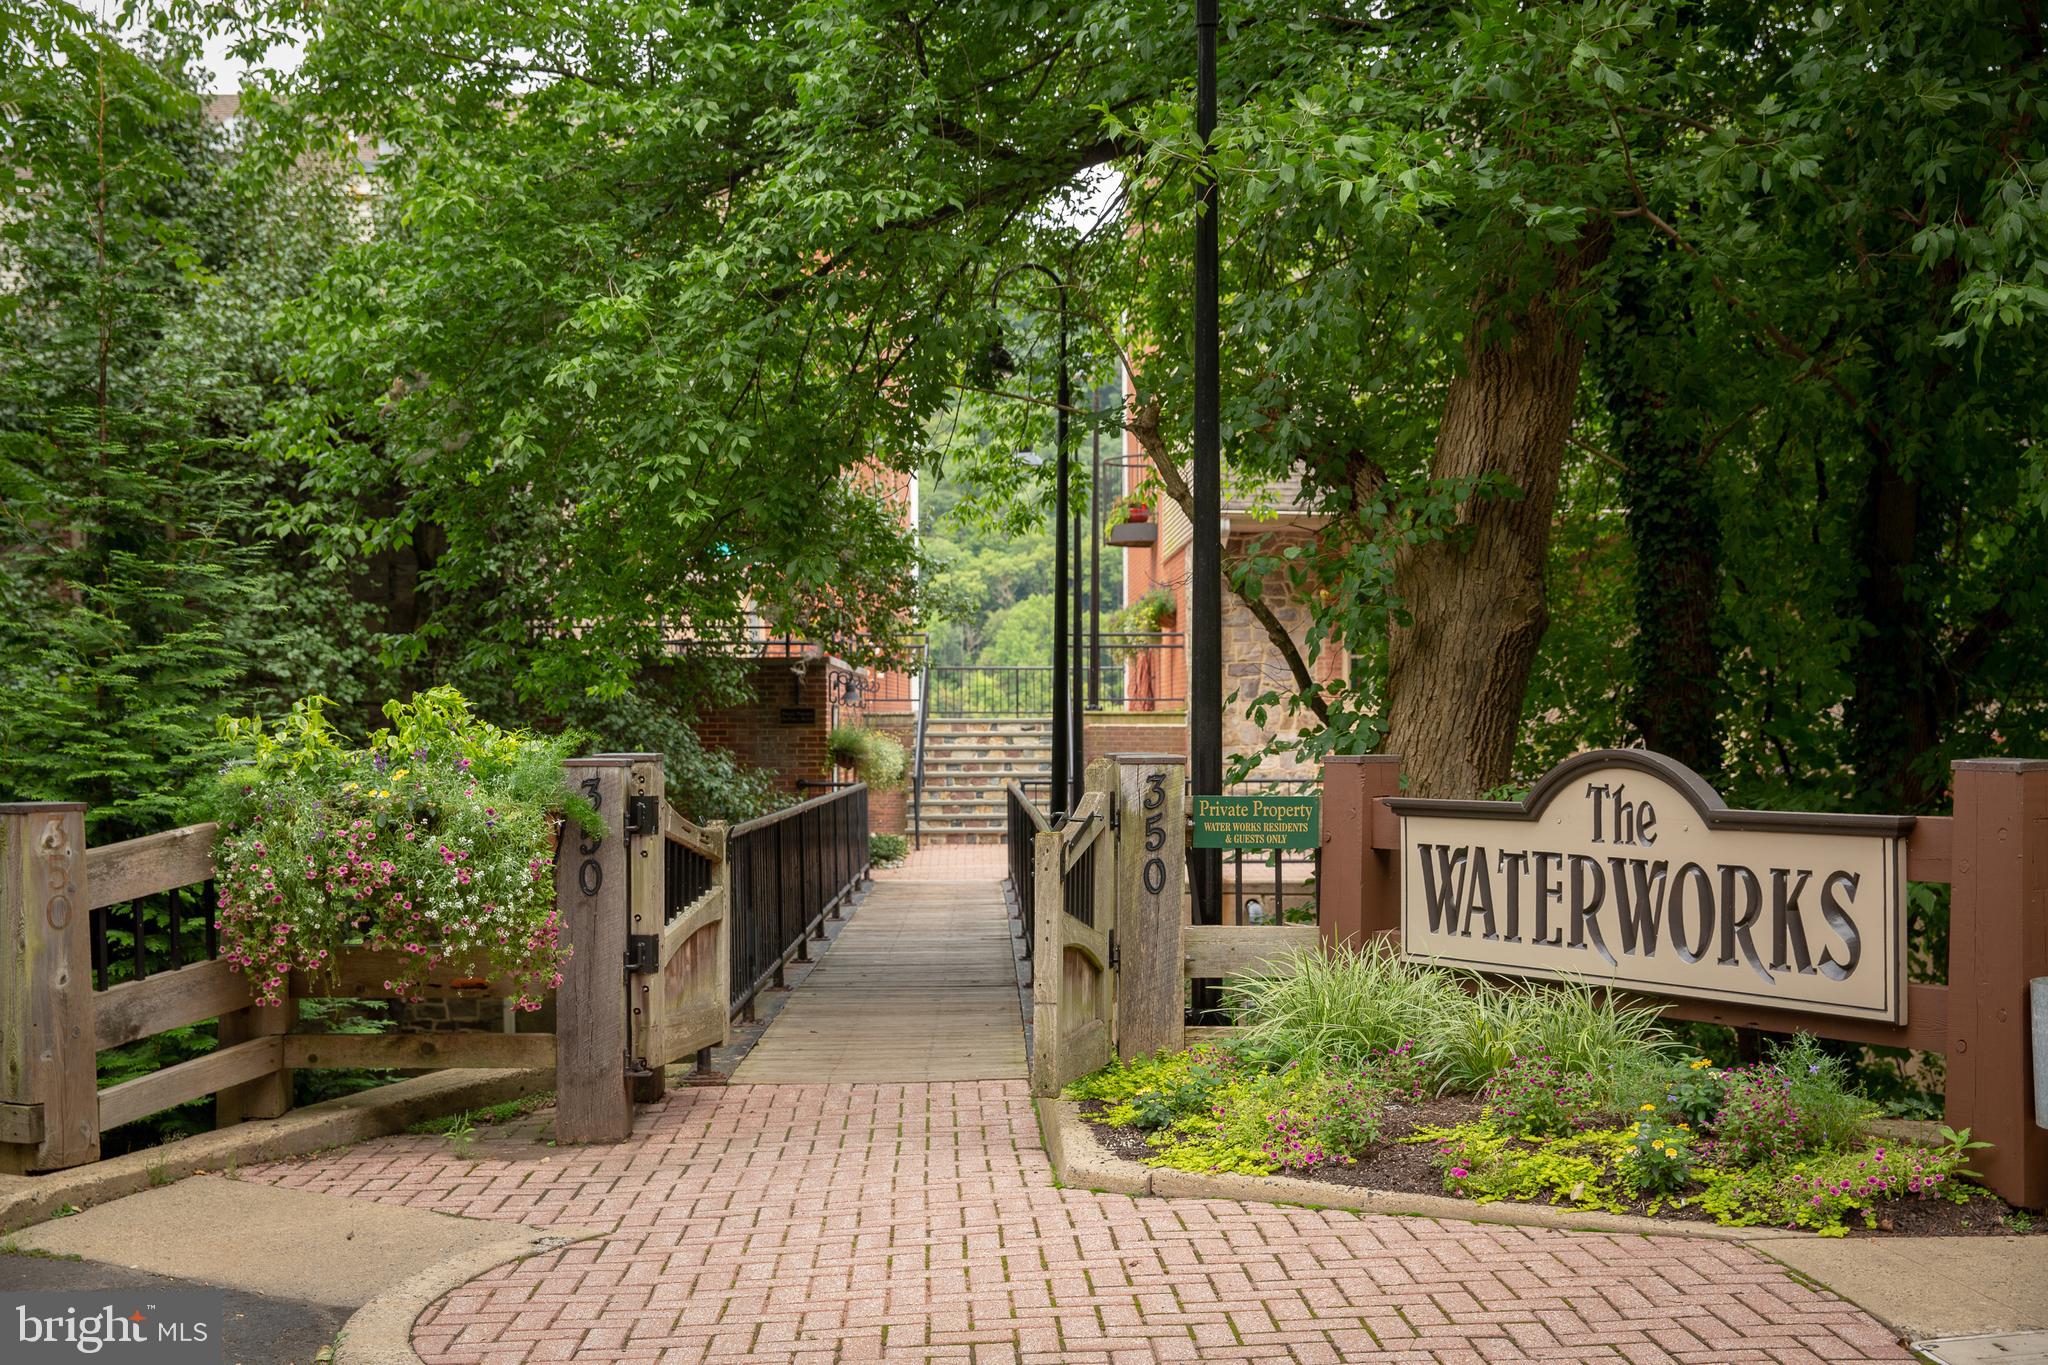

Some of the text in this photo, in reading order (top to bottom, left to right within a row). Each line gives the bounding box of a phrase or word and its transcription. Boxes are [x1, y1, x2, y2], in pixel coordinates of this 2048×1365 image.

[1200, 800, 1313, 821] Private Property
[1204, 823, 1308, 832] WATER WORKS RESIDENTS
[1585, 783, 1658, 847] The
[1143, 774, 1166, 894] 350
[1225, 834, 1287, 844] & GUESTS ONLY
[1417, 844, 1861, 985] WATERWORKS
